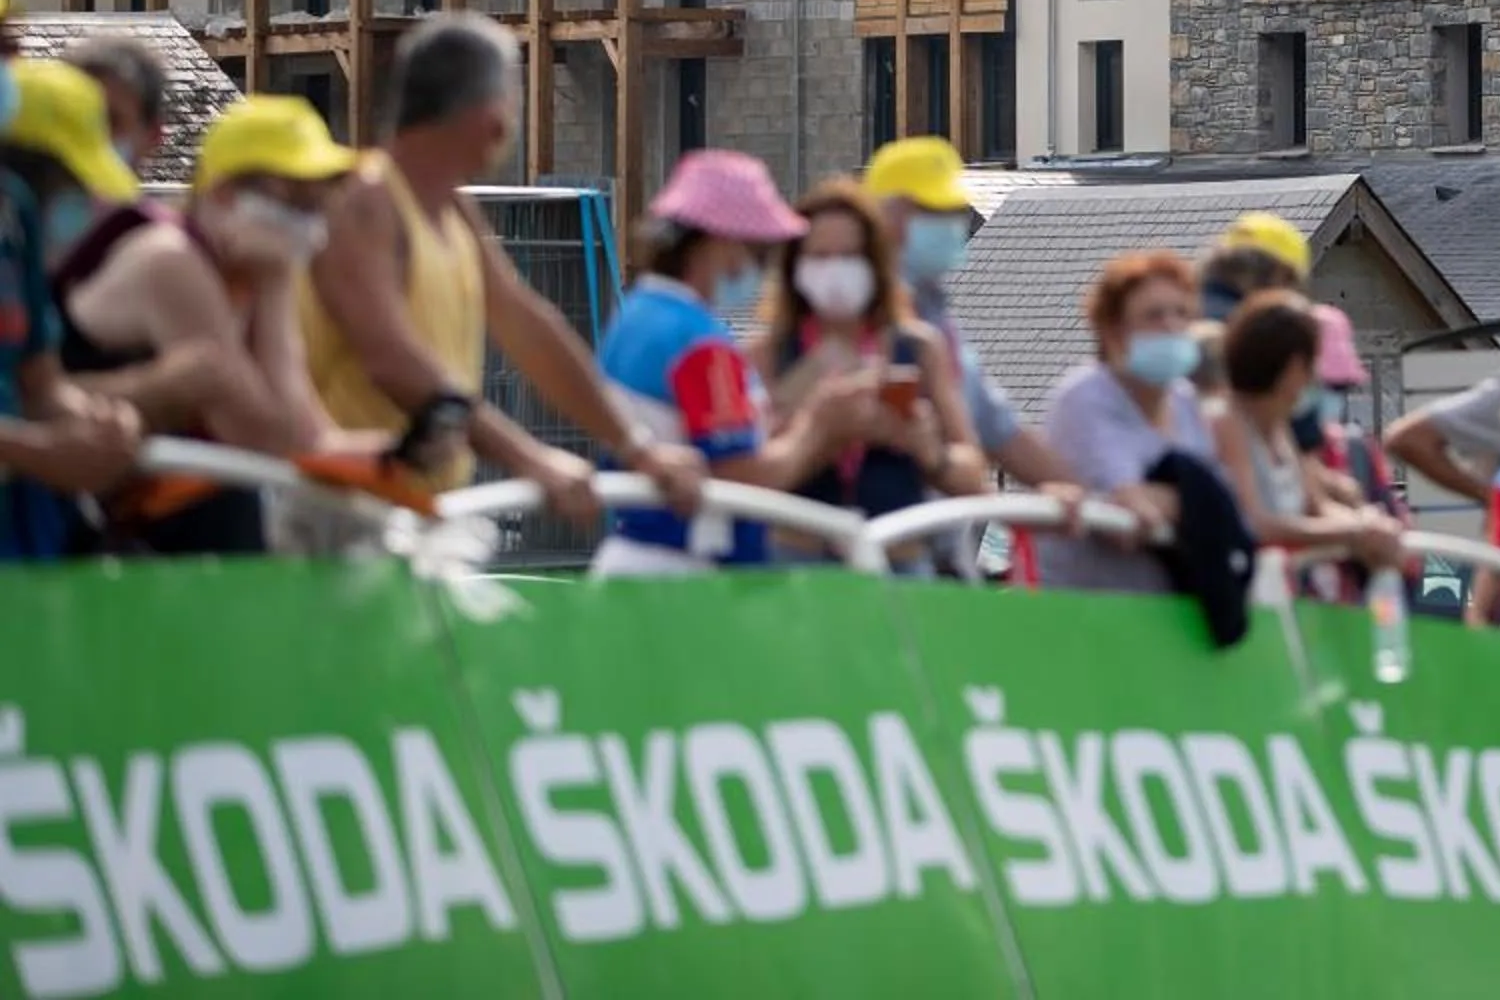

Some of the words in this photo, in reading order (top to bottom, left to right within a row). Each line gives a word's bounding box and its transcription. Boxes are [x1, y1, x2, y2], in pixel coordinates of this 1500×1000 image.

[0, 707, 517, 999] ŠKODA
[508, 687, 977, 942] ŠKODA
[962, 685, 1368, 907] ŠKODA
